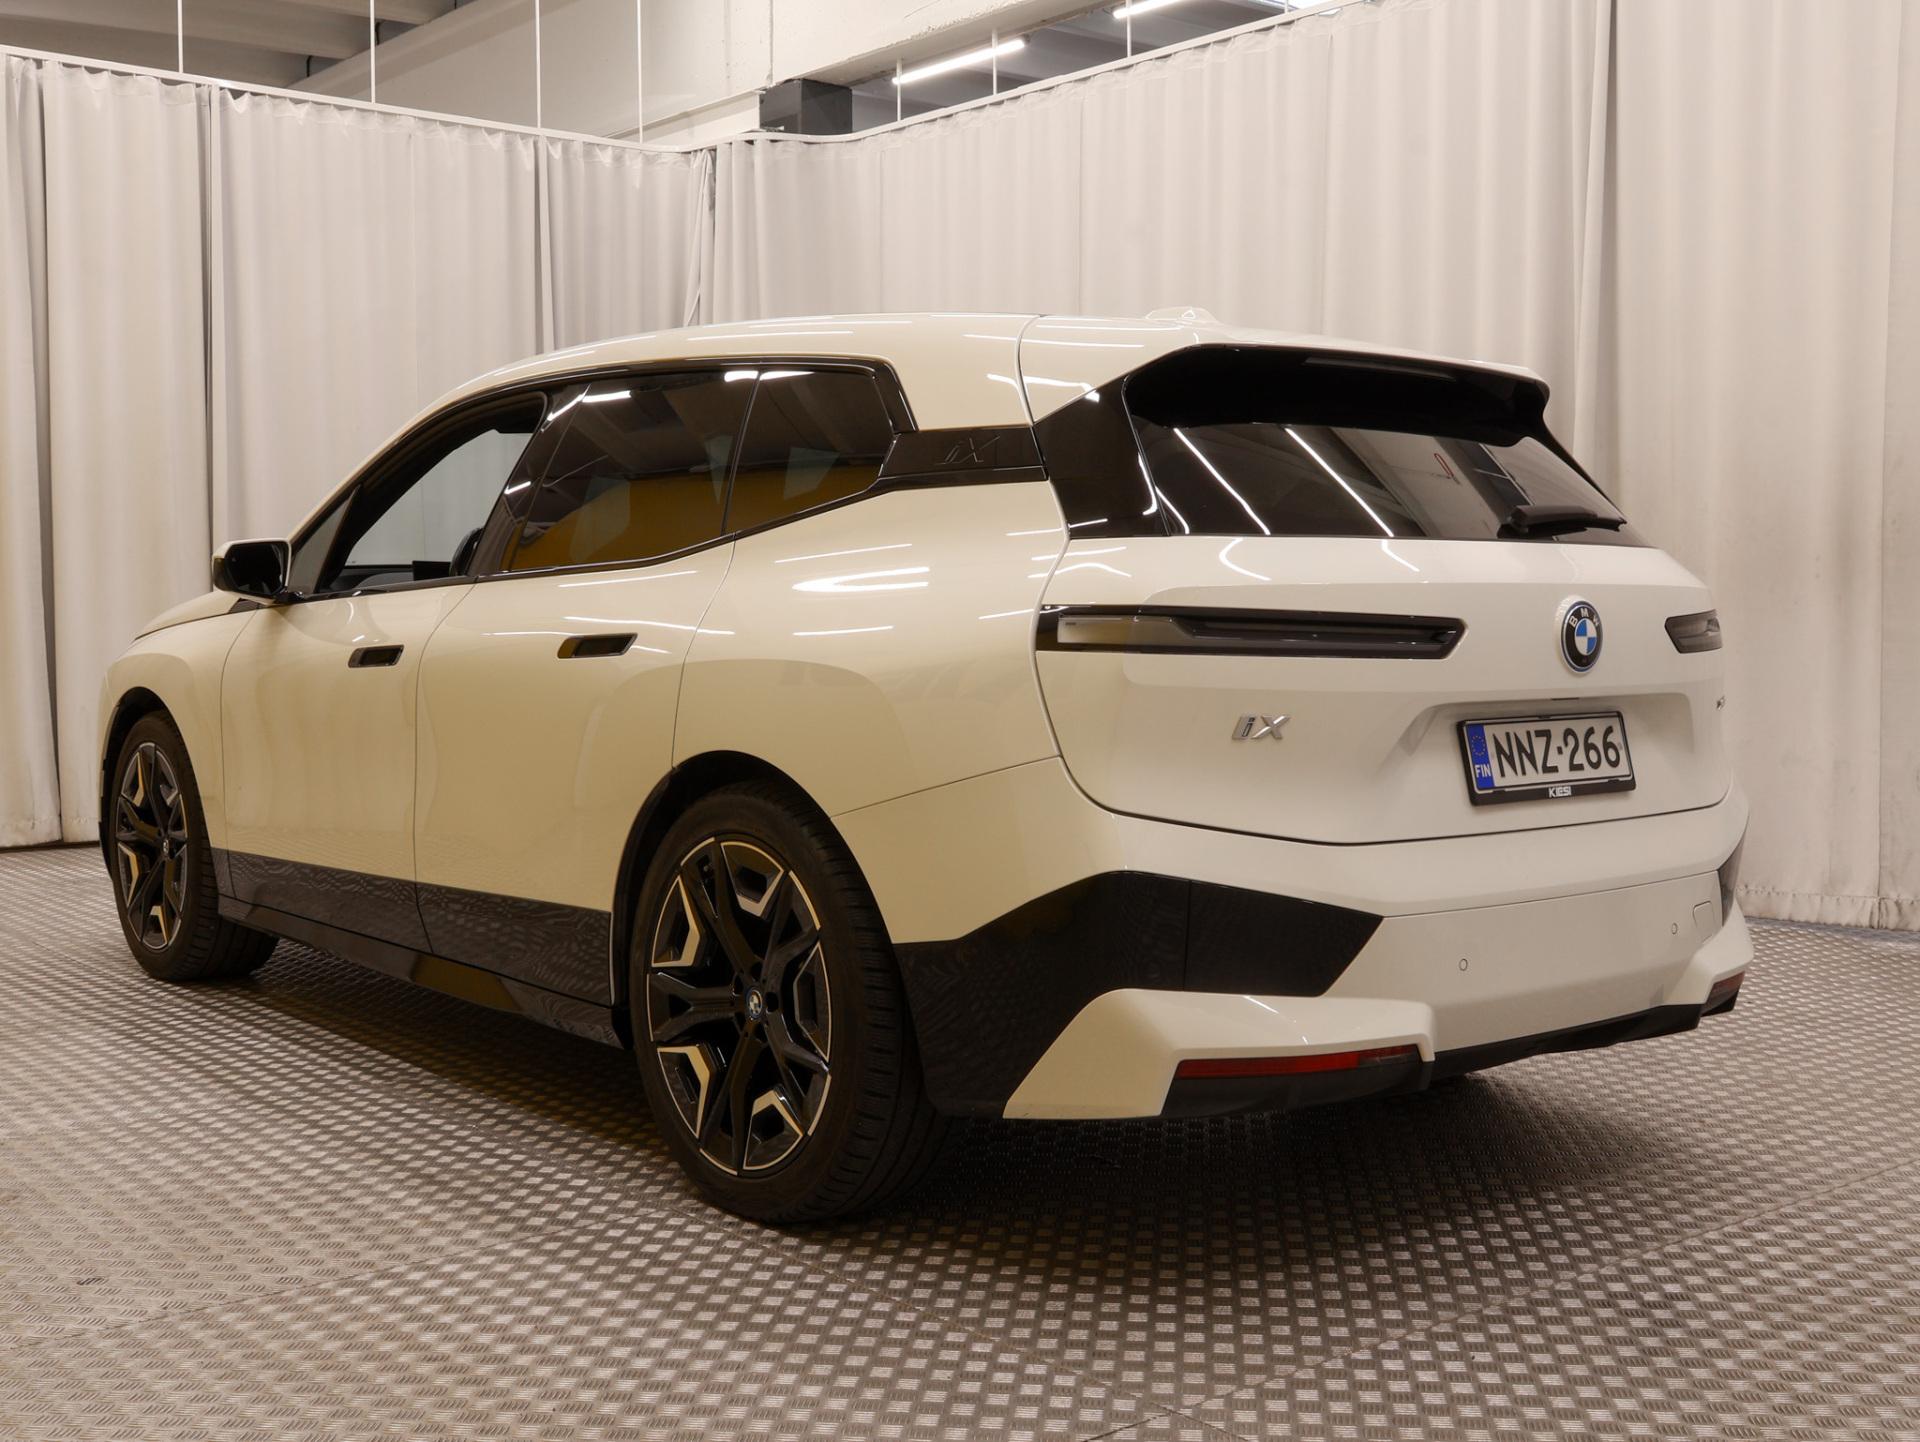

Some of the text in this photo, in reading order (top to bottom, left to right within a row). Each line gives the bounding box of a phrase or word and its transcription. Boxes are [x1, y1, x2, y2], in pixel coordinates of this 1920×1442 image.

[1568, 607, 1600, 628] BMW
[1231, 714, 1291, 741] iX
[1474, 763, 1492, 779] FIN
[1548, 785, 1572, 799] KIESI
